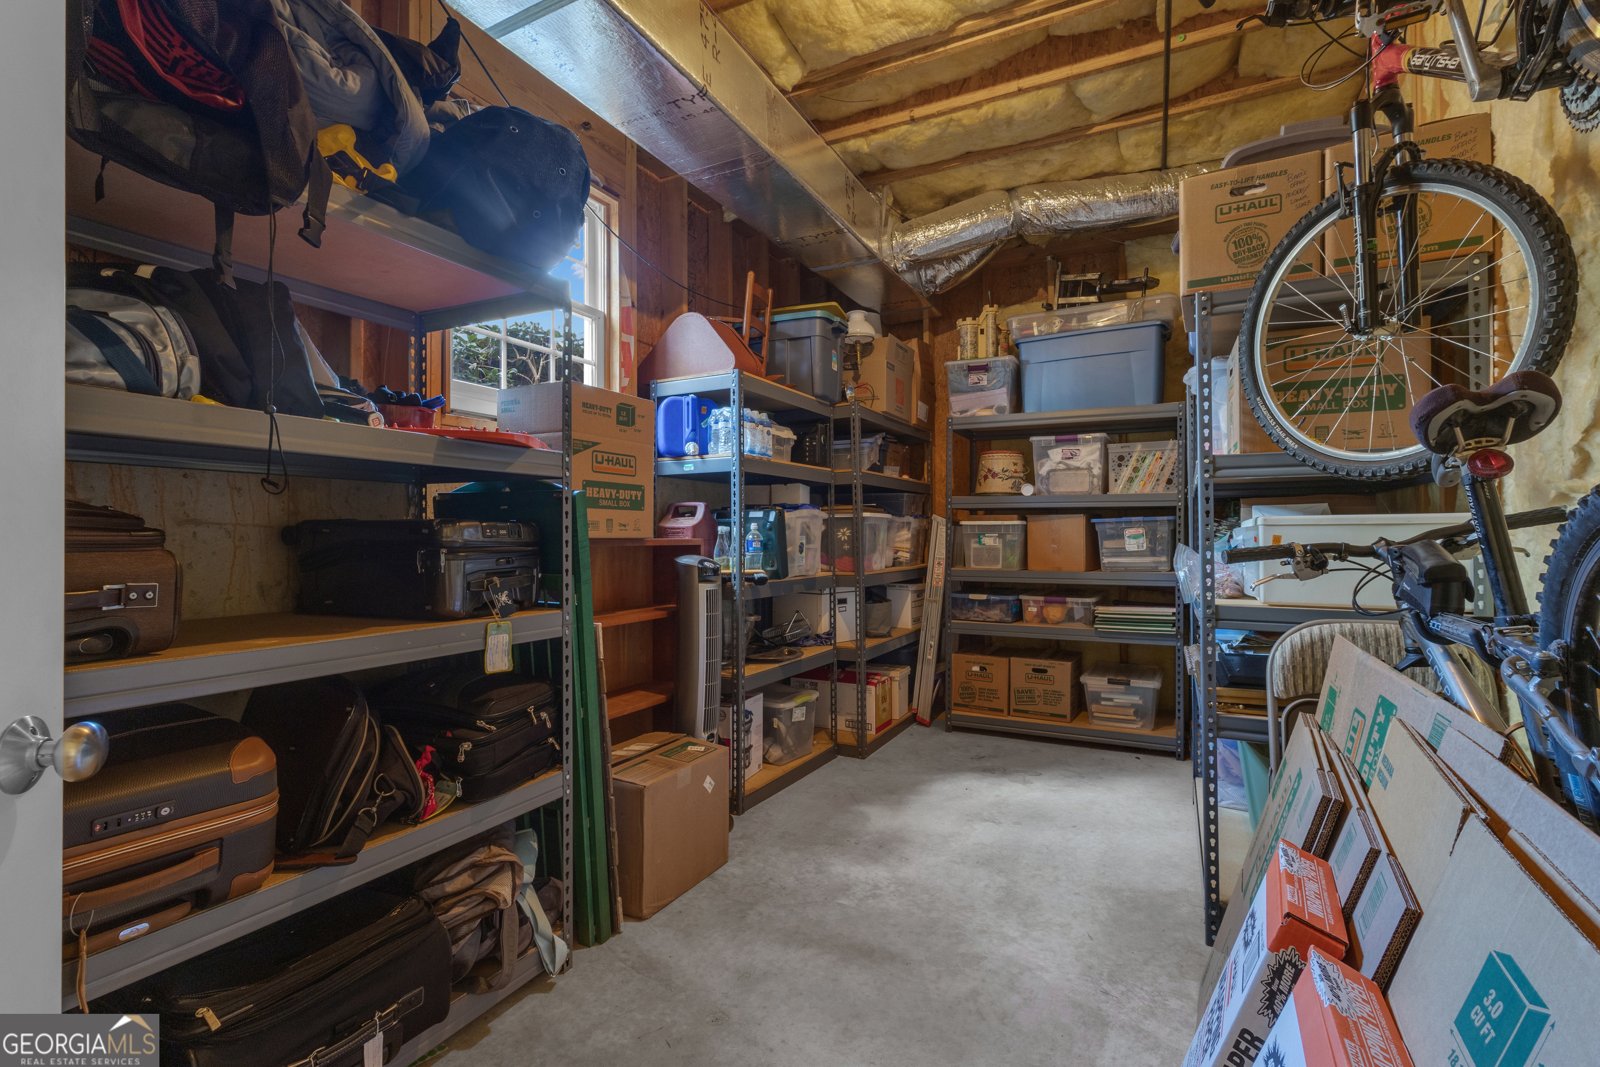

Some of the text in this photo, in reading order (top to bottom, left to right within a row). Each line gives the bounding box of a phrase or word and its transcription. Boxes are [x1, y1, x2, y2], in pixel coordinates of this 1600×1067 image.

[1210, 176, 1255, 190] EASY-TO-LIFT
[1256, 169, 1288, 181] HANDLES
[1219, 197, 1278, 216] U-HAUL
[1232, 232, 1263, 250] 100%
[1274, 425, 1287, 440] TRAIL
[1284, 437, 1299, 449] BIKES
[594, 453, 634, 469] U-HAUL
[586, 486, 642, 501] HEAVY-DUTY
[598, 499, 631, 508] SMALL BOX
[1279, 962, 1296, 994] MORE
[1273, 991, 1286, 1015] 40%
[1483, 989, 1504, 1019] 3.0
[1470, 1005, 1496, 1045] CU FT
